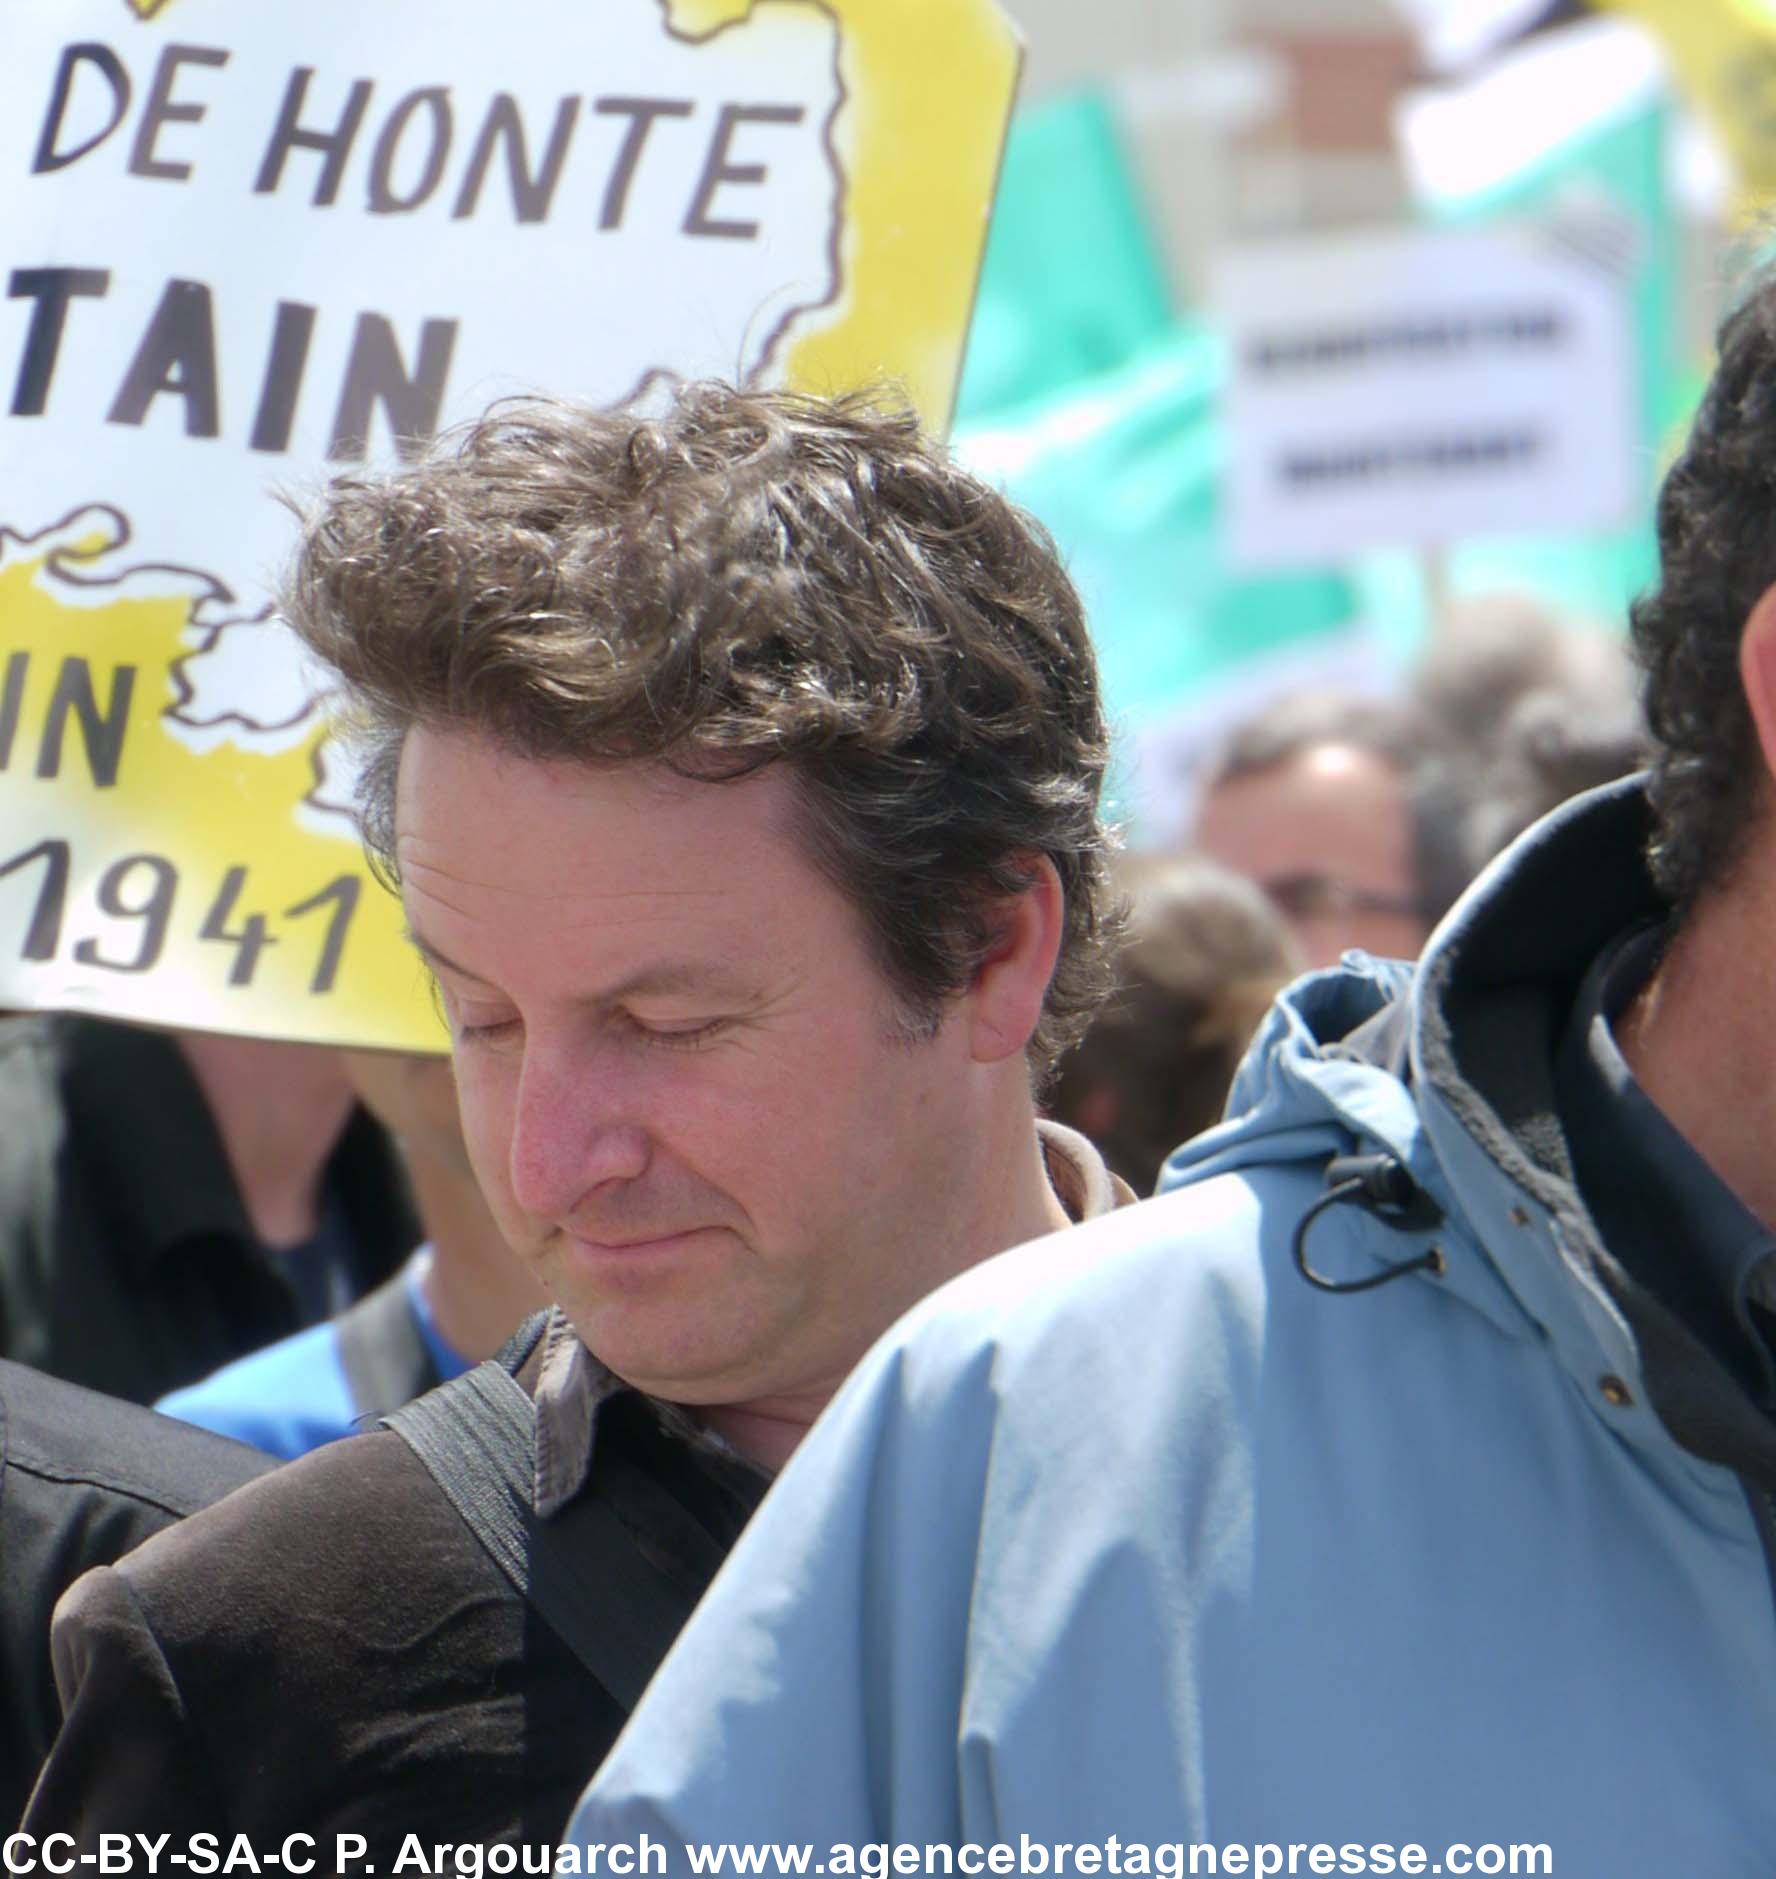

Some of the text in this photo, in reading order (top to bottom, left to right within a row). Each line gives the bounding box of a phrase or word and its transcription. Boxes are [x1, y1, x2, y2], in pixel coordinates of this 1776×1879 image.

[30, 40, 807, 240] DE HONTE
[7, 266, 459, 464] TAIN
[0, 837, 363, 994] 1941
